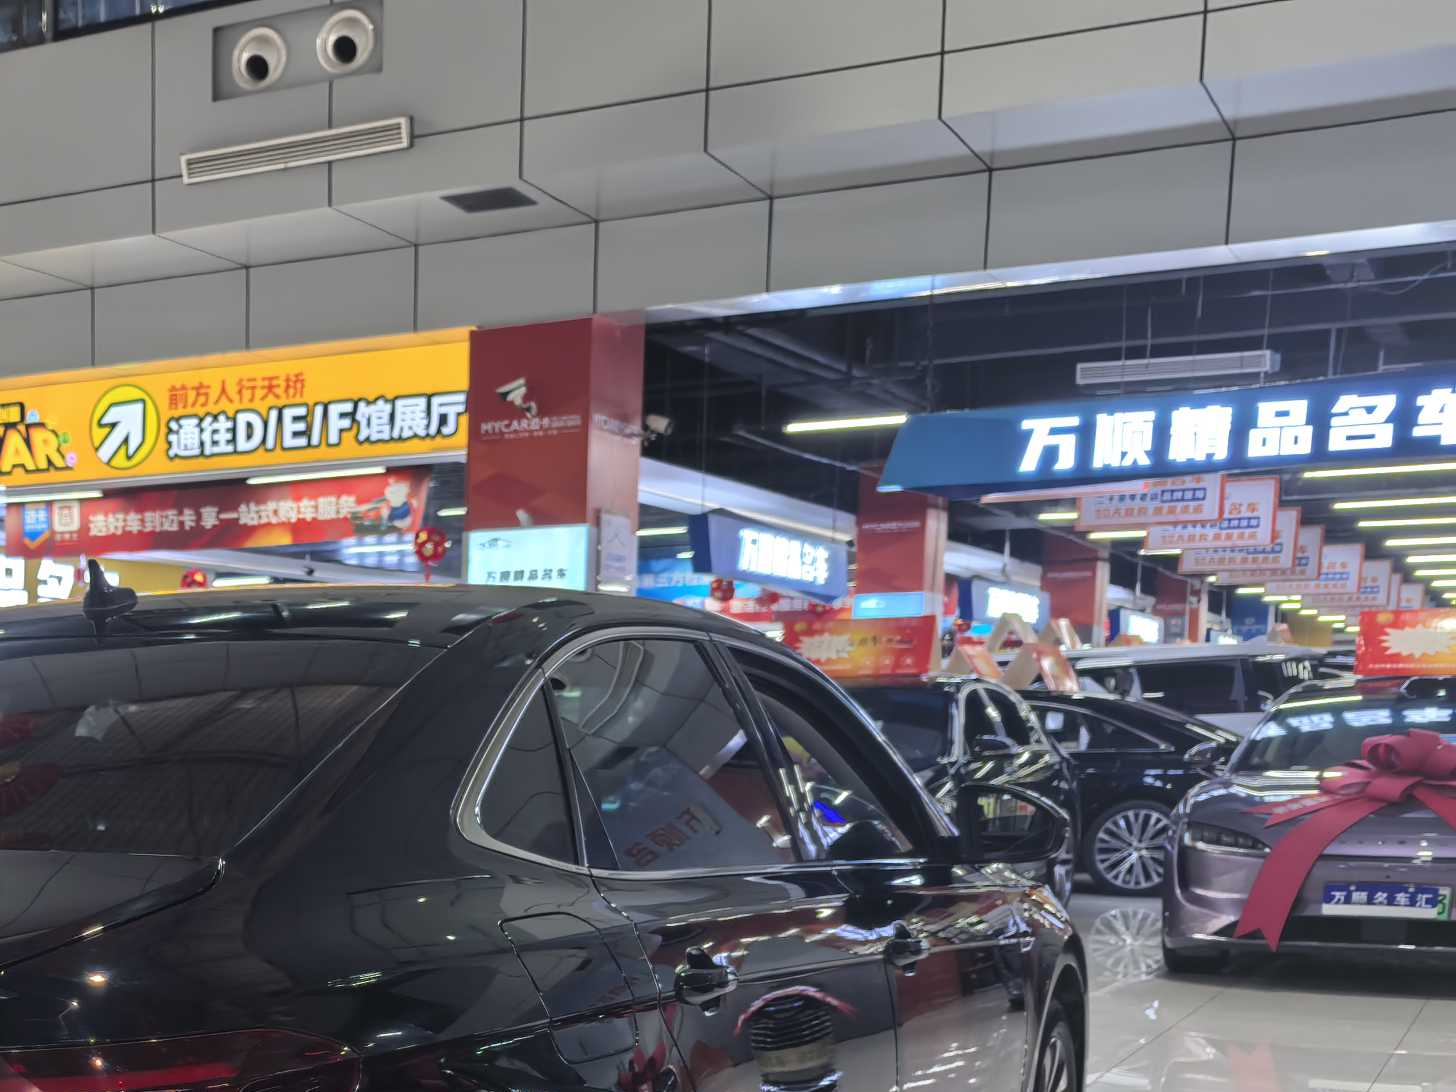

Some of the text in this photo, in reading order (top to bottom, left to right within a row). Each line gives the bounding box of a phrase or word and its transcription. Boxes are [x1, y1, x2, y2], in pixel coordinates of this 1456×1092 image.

[167, 372, 306, 410] 前方人行天桥
[167, 392, 468, 460] 通往D/E/F馆展厅
[89, 494, 357, 537] 选好车到迈卡 享一站式购车服务
